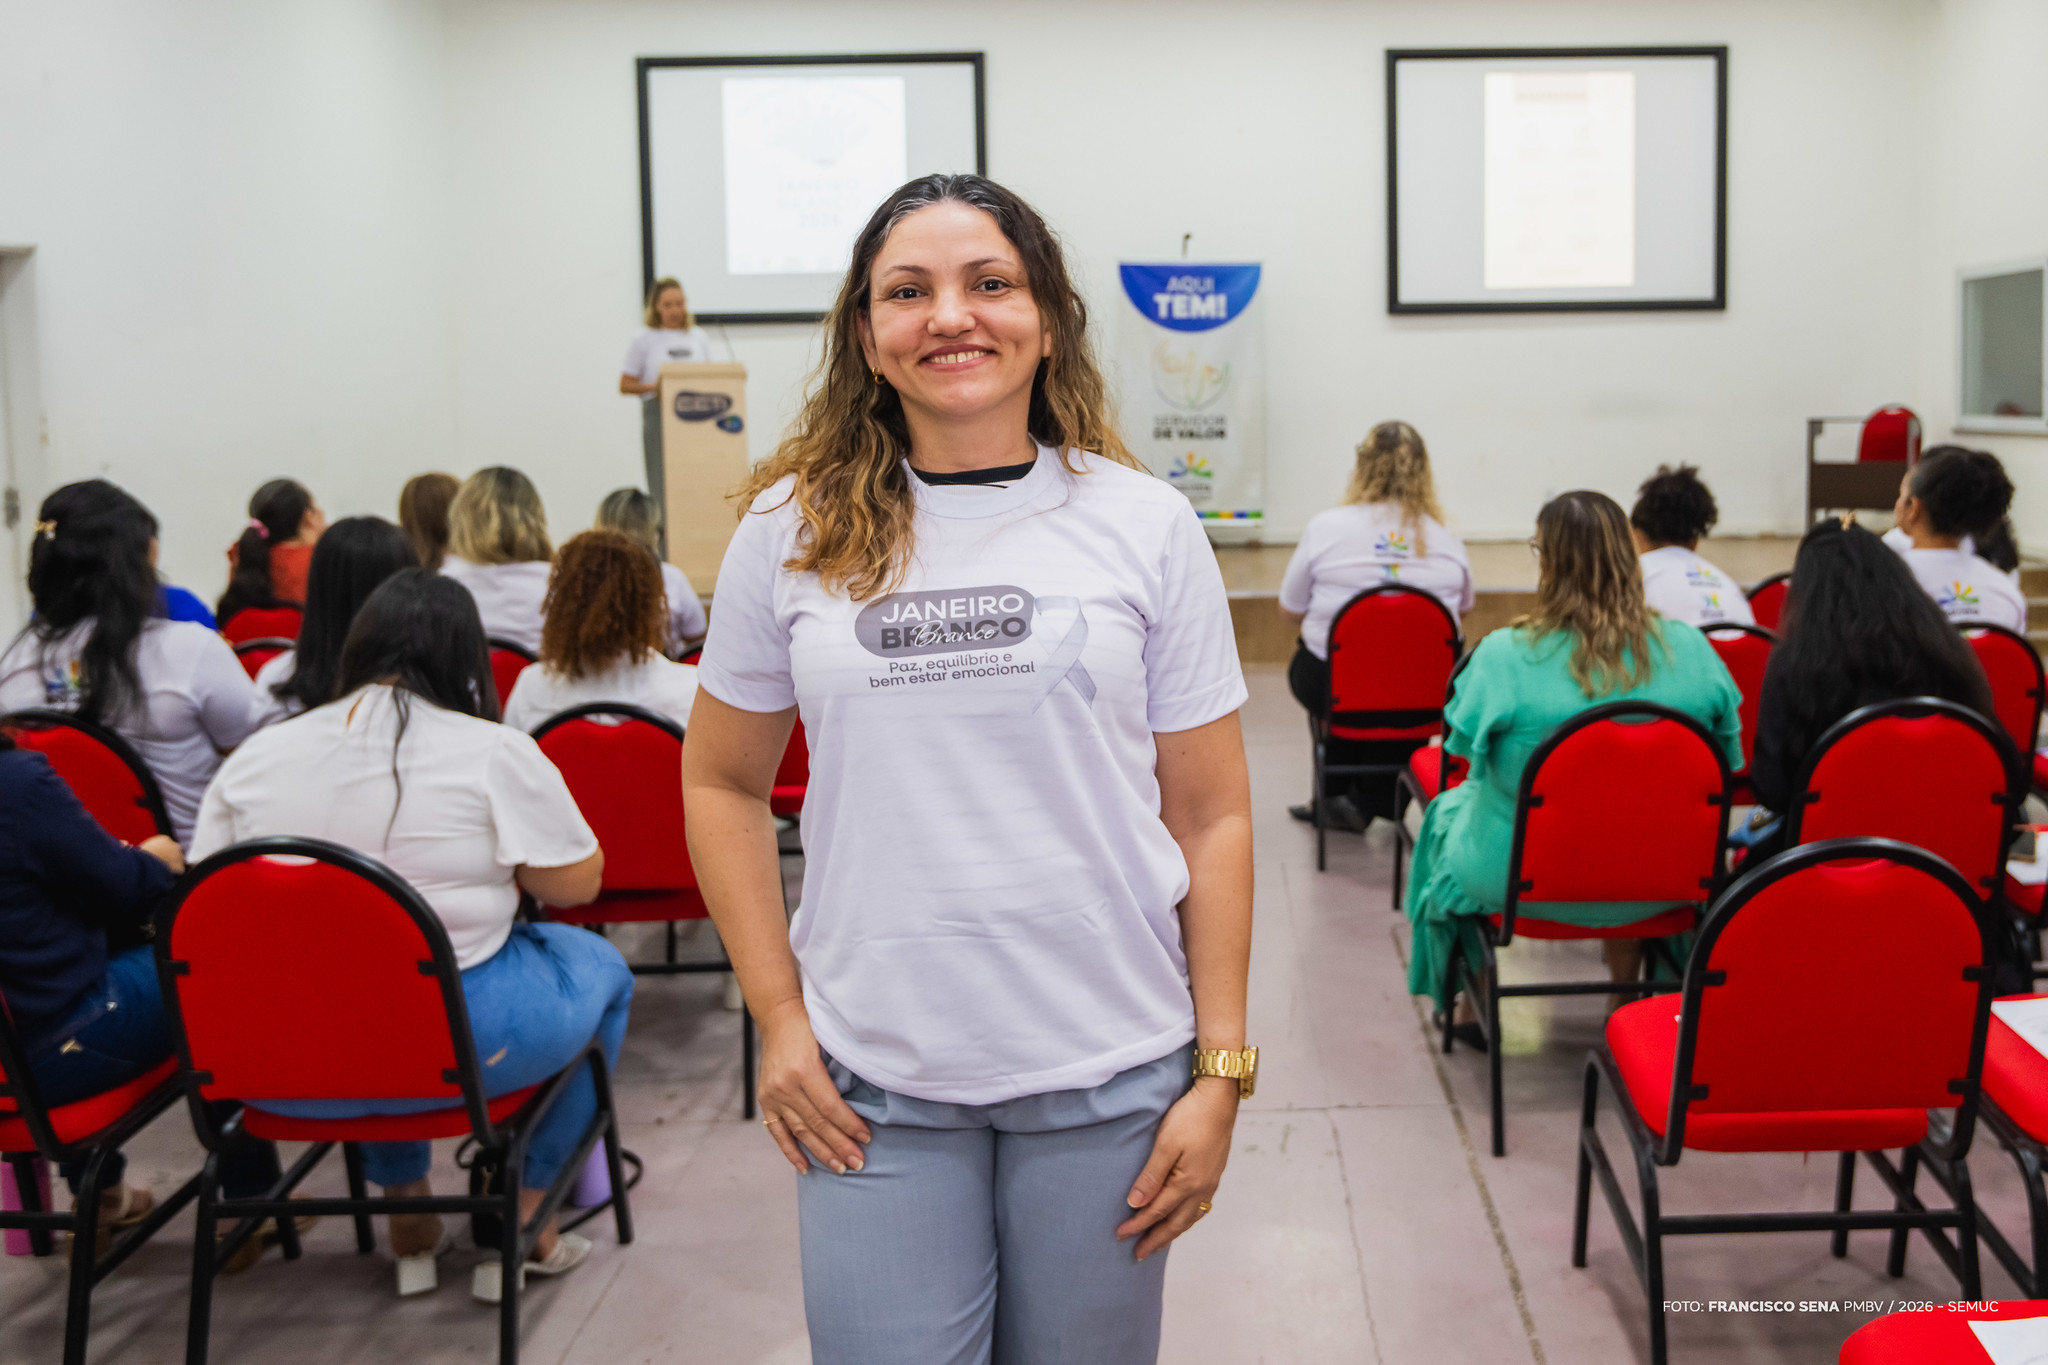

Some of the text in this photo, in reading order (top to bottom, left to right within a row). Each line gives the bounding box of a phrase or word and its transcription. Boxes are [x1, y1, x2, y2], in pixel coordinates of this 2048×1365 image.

[1166, 275, 1215, 293] AQUI
[882, 594, 1024, 623] JANEIRO
[888, 652, 1013, 674] Paz, equilíbrio e
[869, 662, 1035, 689] bem estar emocional
